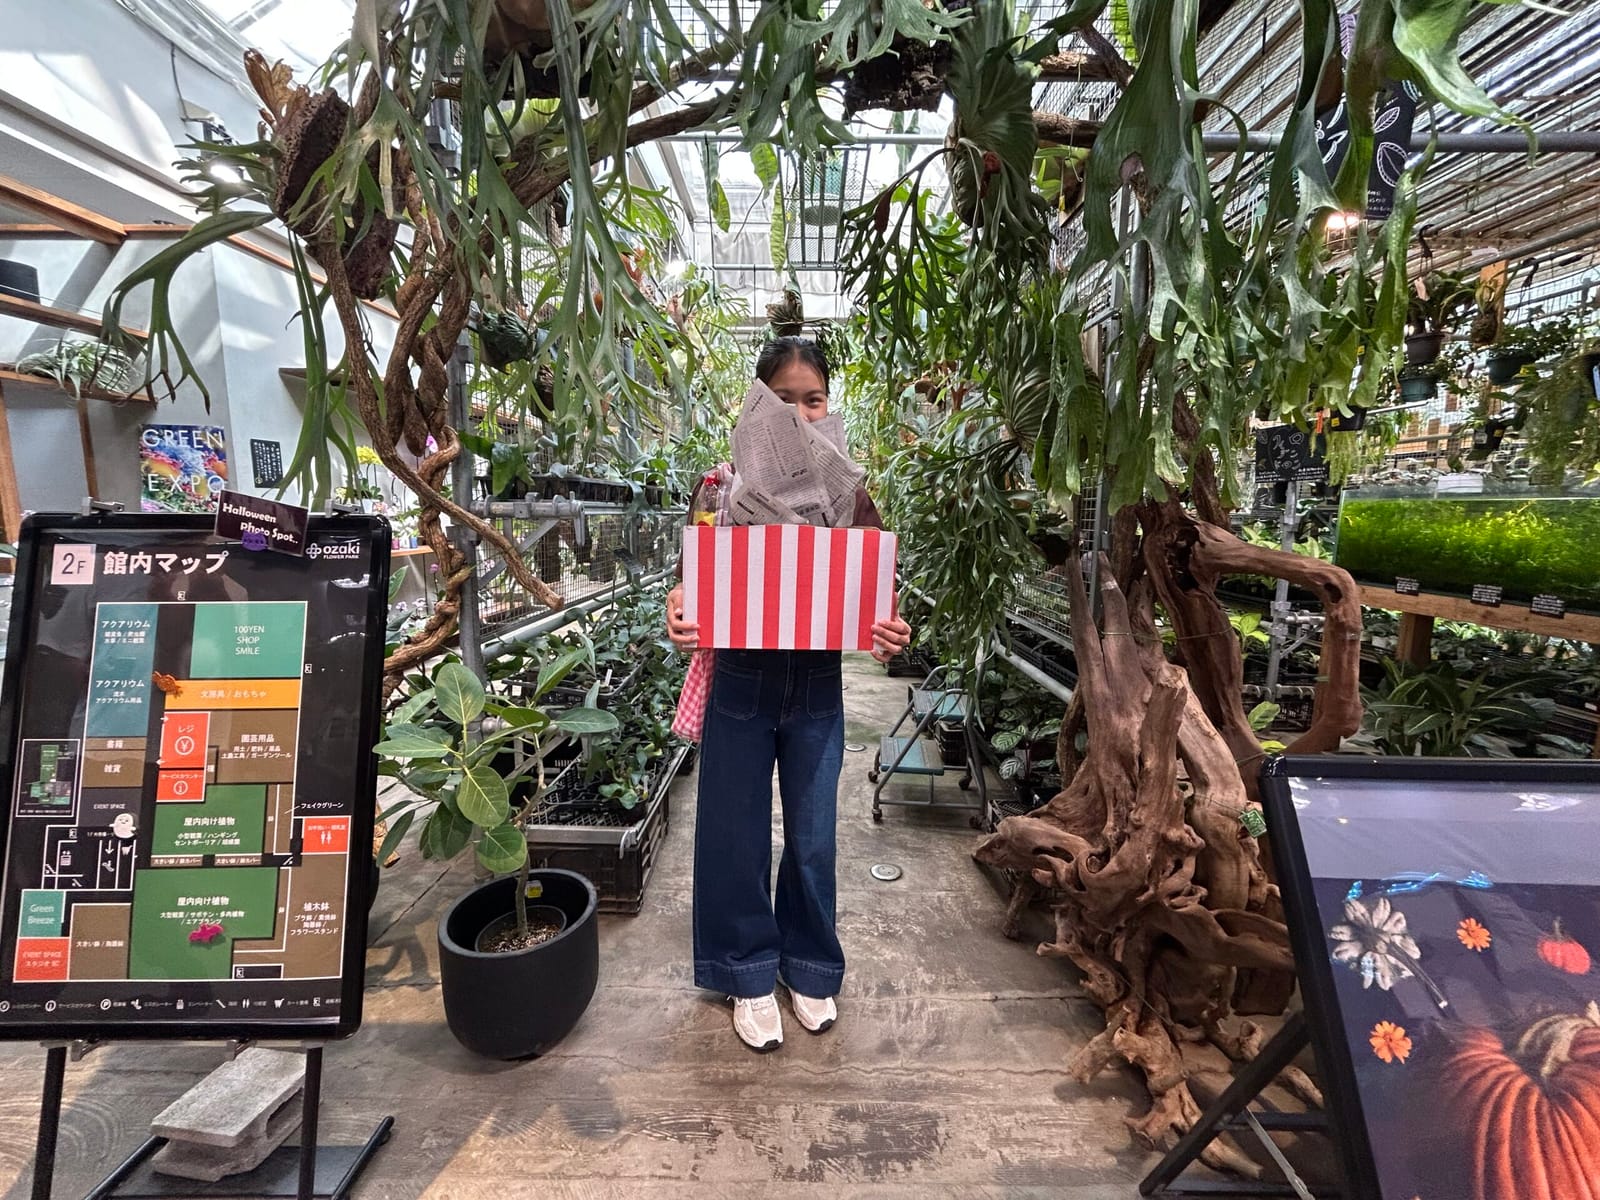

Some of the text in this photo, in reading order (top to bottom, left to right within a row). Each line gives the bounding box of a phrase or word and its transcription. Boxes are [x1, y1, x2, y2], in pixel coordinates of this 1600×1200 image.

[142, 428, 224, 450] GREEN
[147, 473, 225, 493] EXPO
[223, 503, 277, 523] Halloween
[323, 542, 360, 555] ozaki
[103, 551, 230, 575] 館内マップ
[101, 620, 151, 629] アクアリウム
[234, 625, 265, 634] 100YEN
[236, 635, 260, 645] SHOP
[235, 646, 260, 656] SMILE
[95, 680, 145, 688] アクアリウム
[178, 724, 195, 733] レジ
[183, 817, 236, 826] 屋内向け植物
[177, 896, 230, 906] 屋内向け植物
[29, 903, 55, 913] Green
[303, 902, 330, 911] 植木鉢
[290, 928, 339, 936] フラワースタンド
